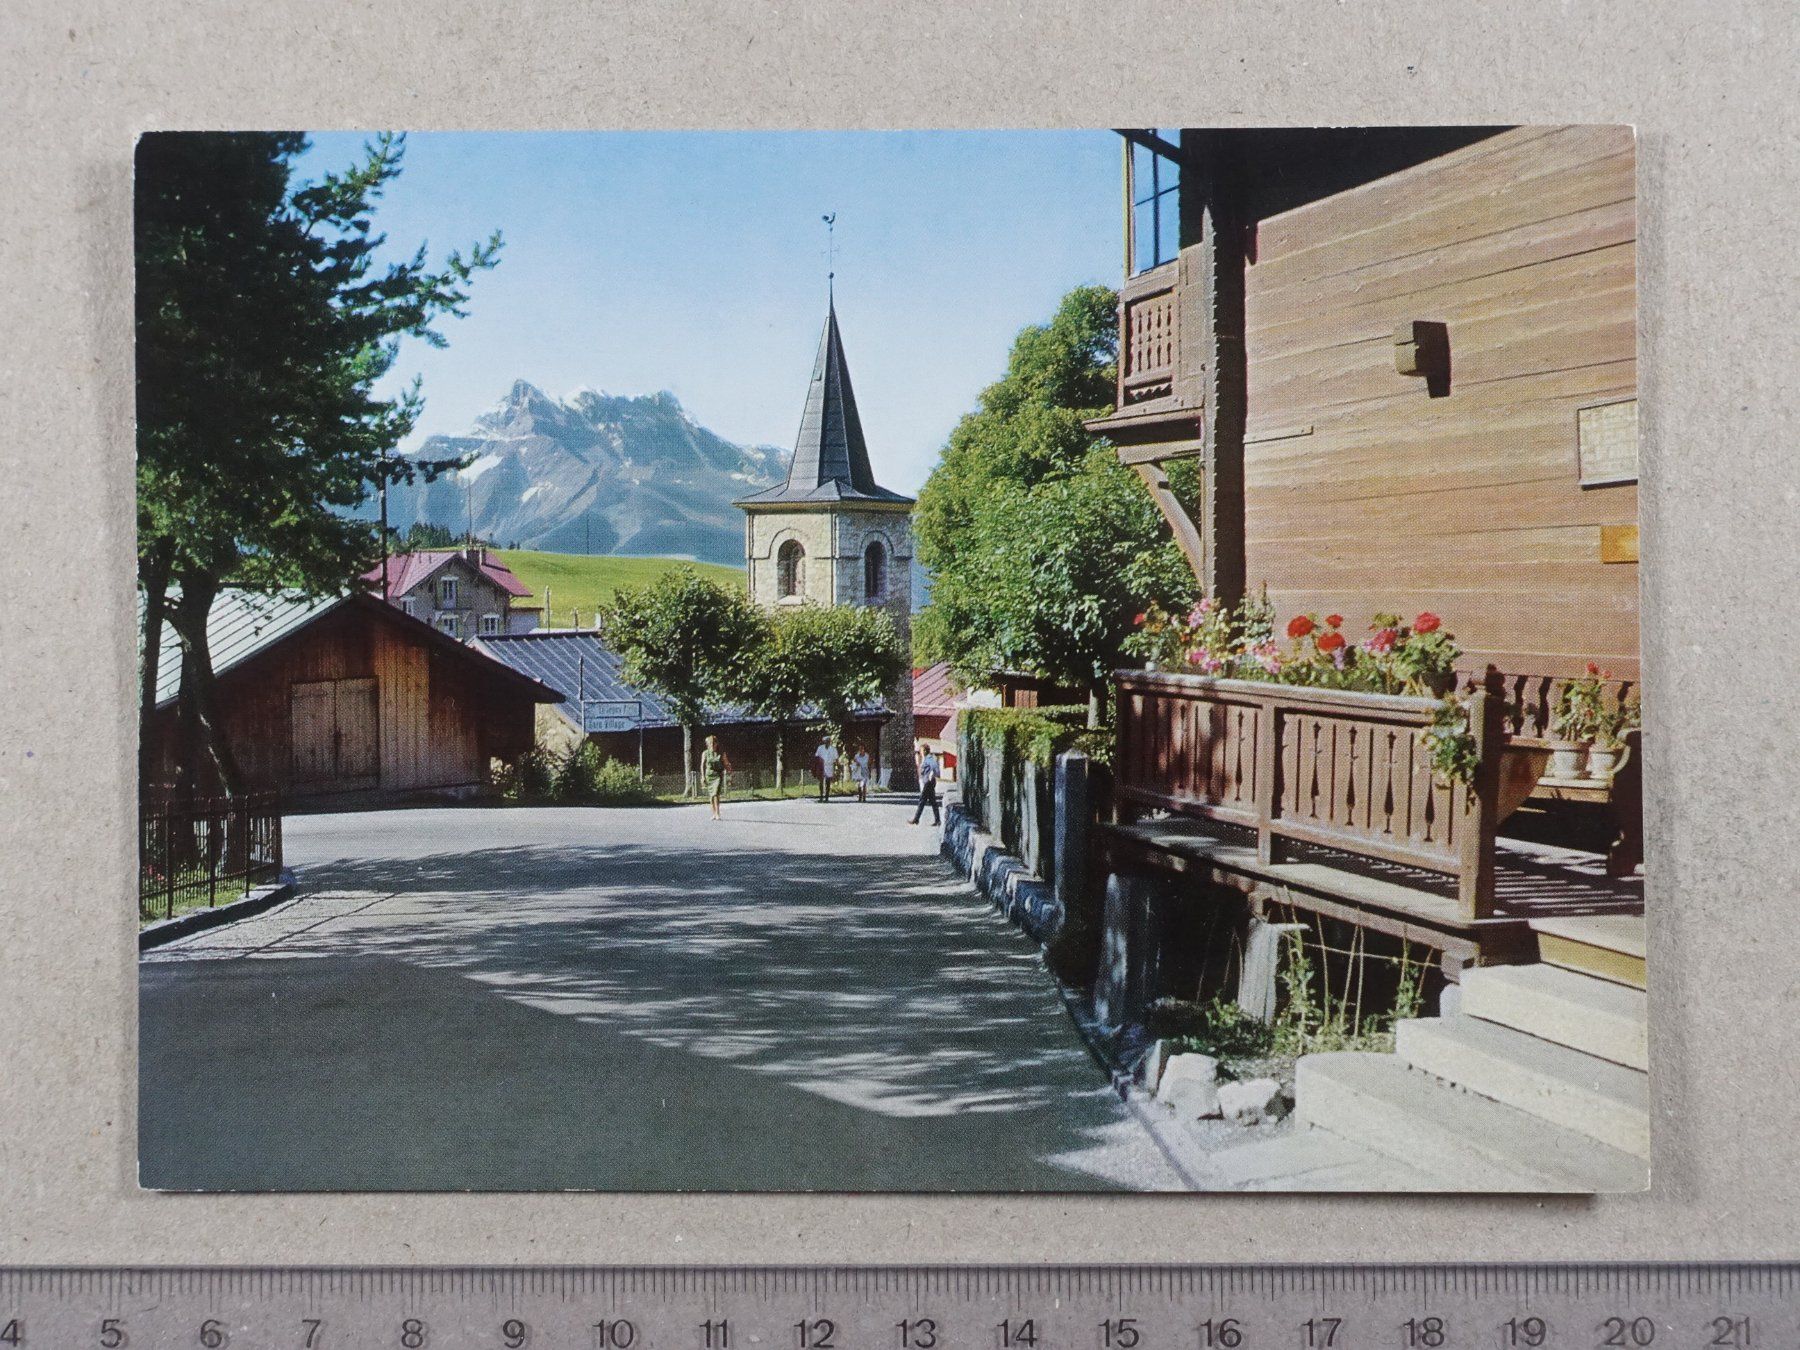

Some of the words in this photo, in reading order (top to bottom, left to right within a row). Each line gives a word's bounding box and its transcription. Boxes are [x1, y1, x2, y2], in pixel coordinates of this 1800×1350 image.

[0, 1320, 21, 1347] 4
[101, 1319, 121, 1348] 5
[200, 1320, 222, 1348] 6
[303, 1320, 321, 1348] 7
[402, 1319, 423, 1348] 8
[503, 1320, 525, 1348] 9
[593, 1319, 634, 1348] 10
[699, 1320, 727, 1348] 11
[794, 1319, 834, 1348] 12
[896, 1319, 936, 1348] 13
[997, 1319, 1037, 1348] 14
[1098, 1319, 1139, 1348] 15
[1200, 1318, 1241, 1348] 16
[1302, 1318, 1341, 1346] 17
[1403, 1317, 1444, 1347] 18
[1505, 1317, 1546, 1346] 19
[1604, 1317, 1655, 1346] 20
[1712, 1316, 1750, 1345] 21
